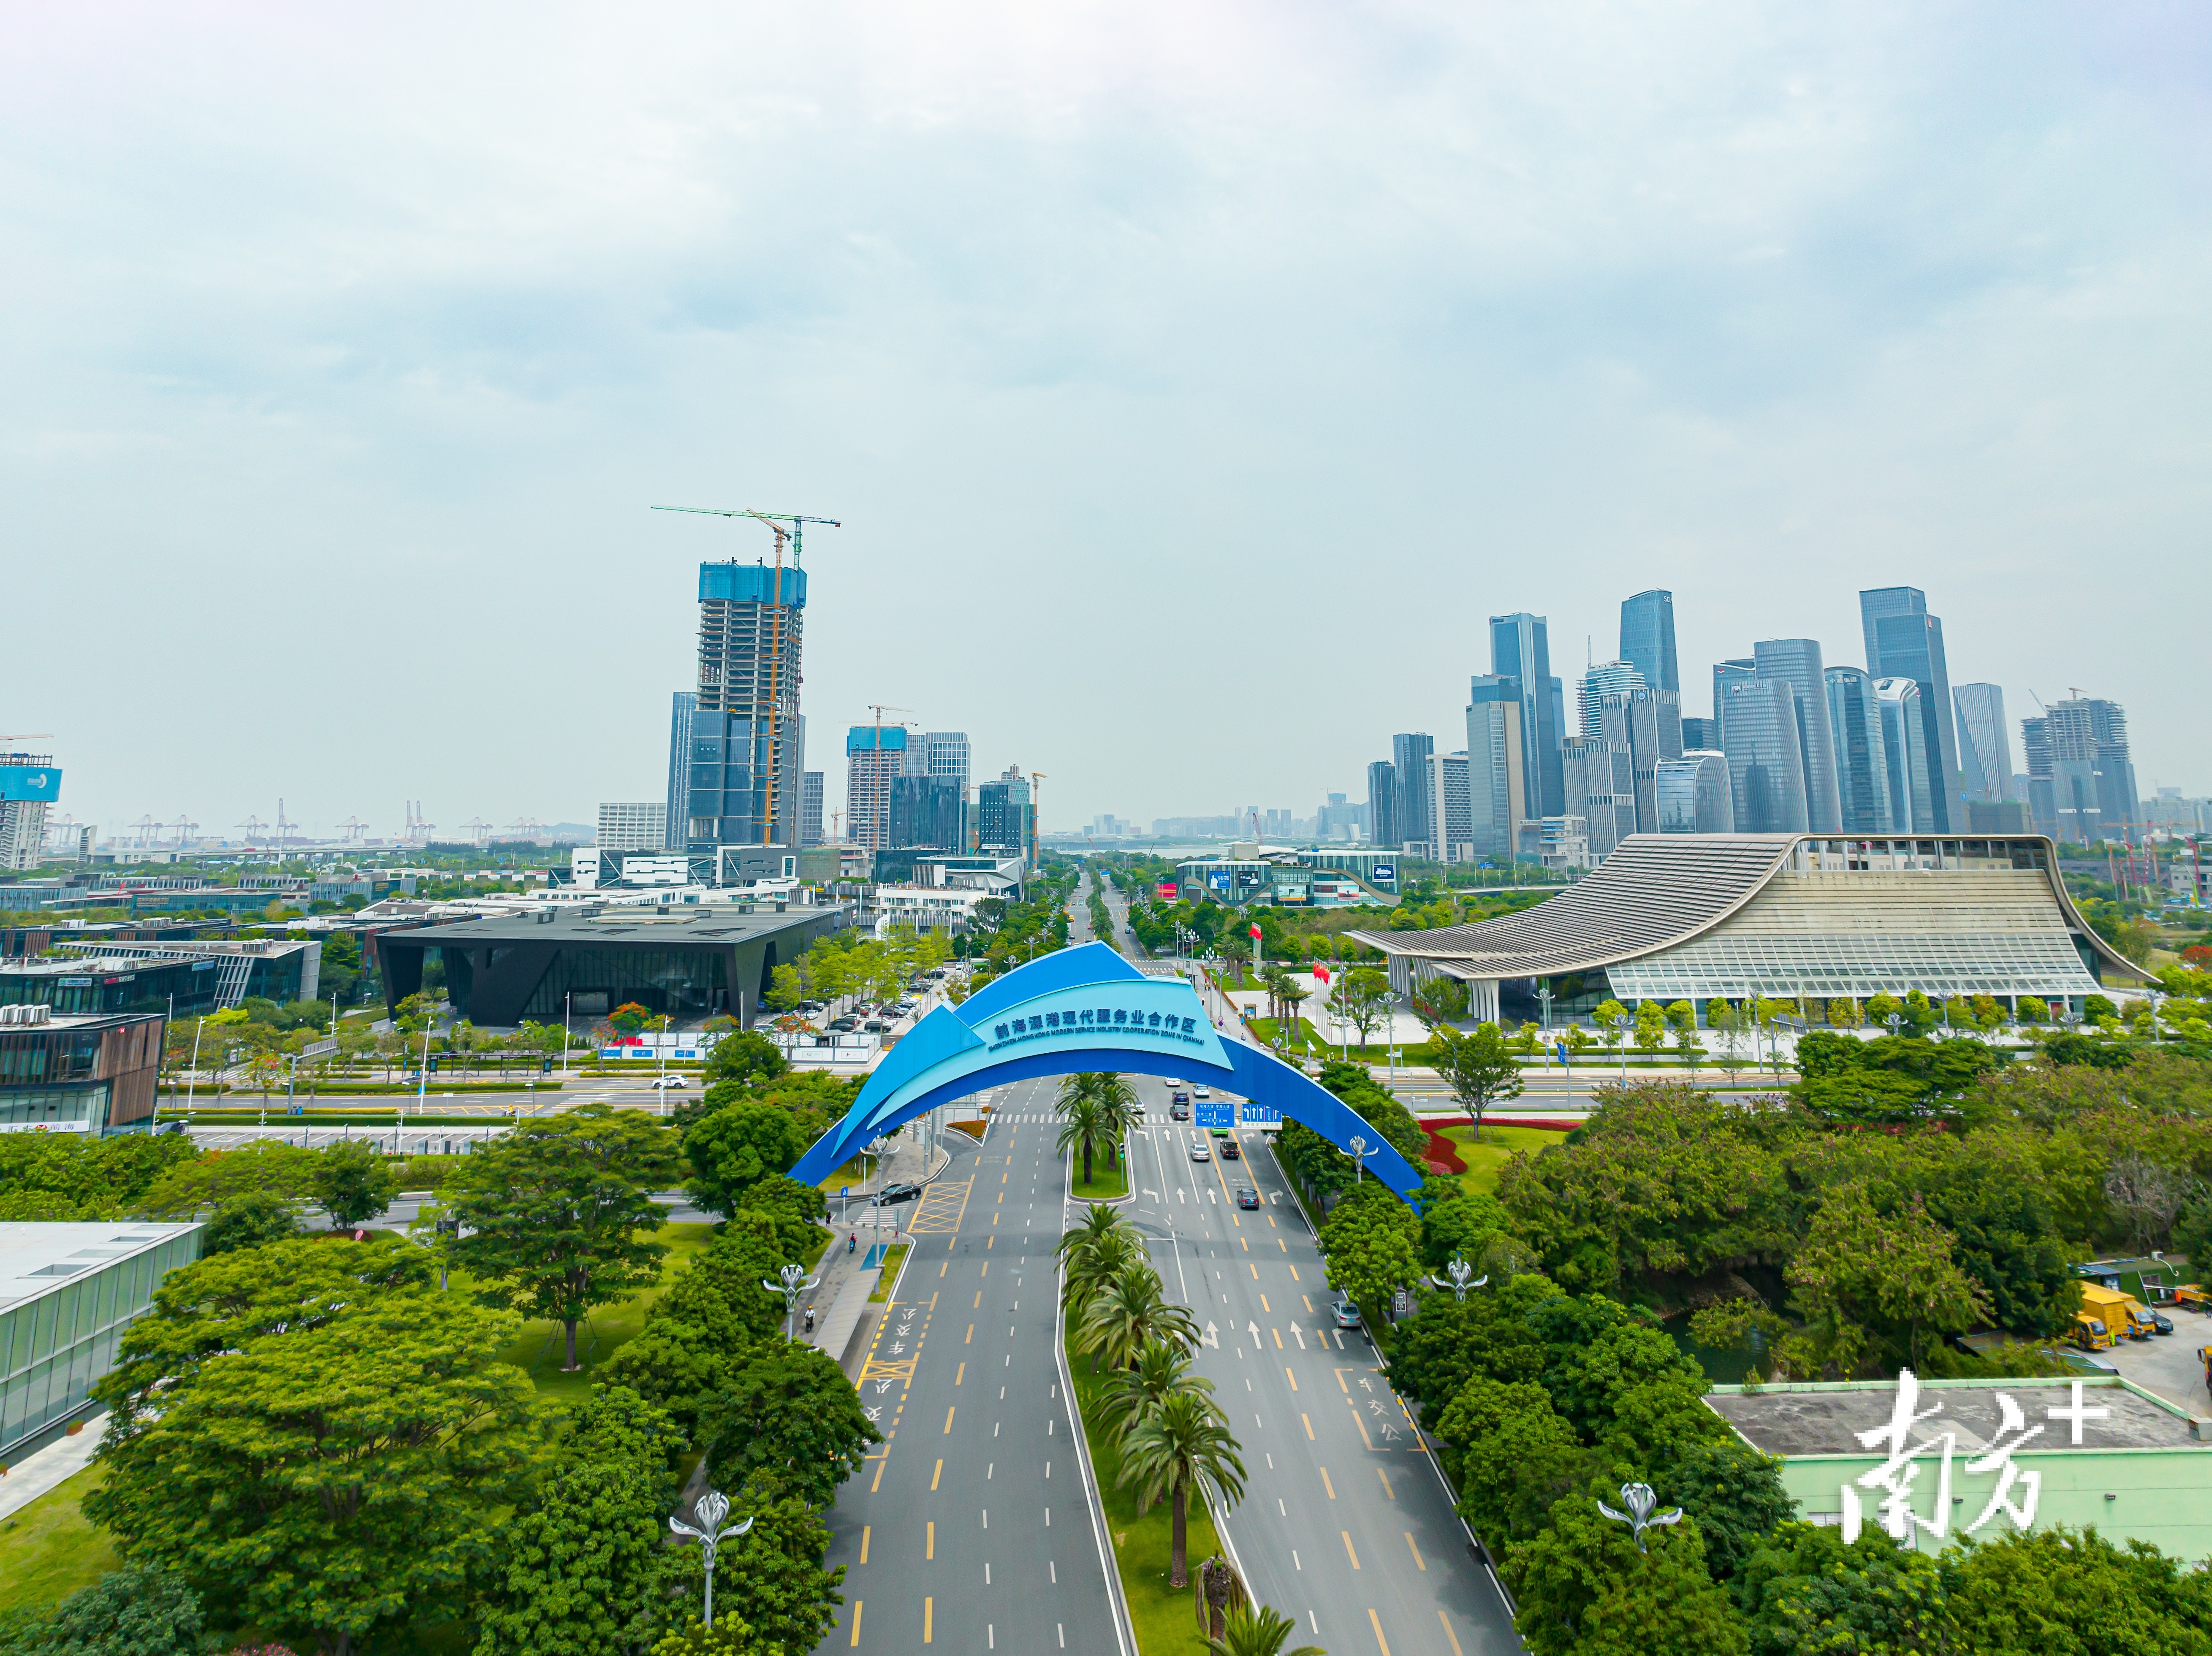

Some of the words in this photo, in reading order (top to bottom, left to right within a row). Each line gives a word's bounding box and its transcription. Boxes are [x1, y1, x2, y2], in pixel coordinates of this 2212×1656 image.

[994, 1008, 1196, 1039] 前海深港现代服务业合作区
[1122, 1027, 1160, 1035] COOPERATION
[1161, 1030, 1175, 1038] ZONE
[1183, 1035, 1205, 1045] QIANHAI
[50, 1123, 75, 1131] 前海
